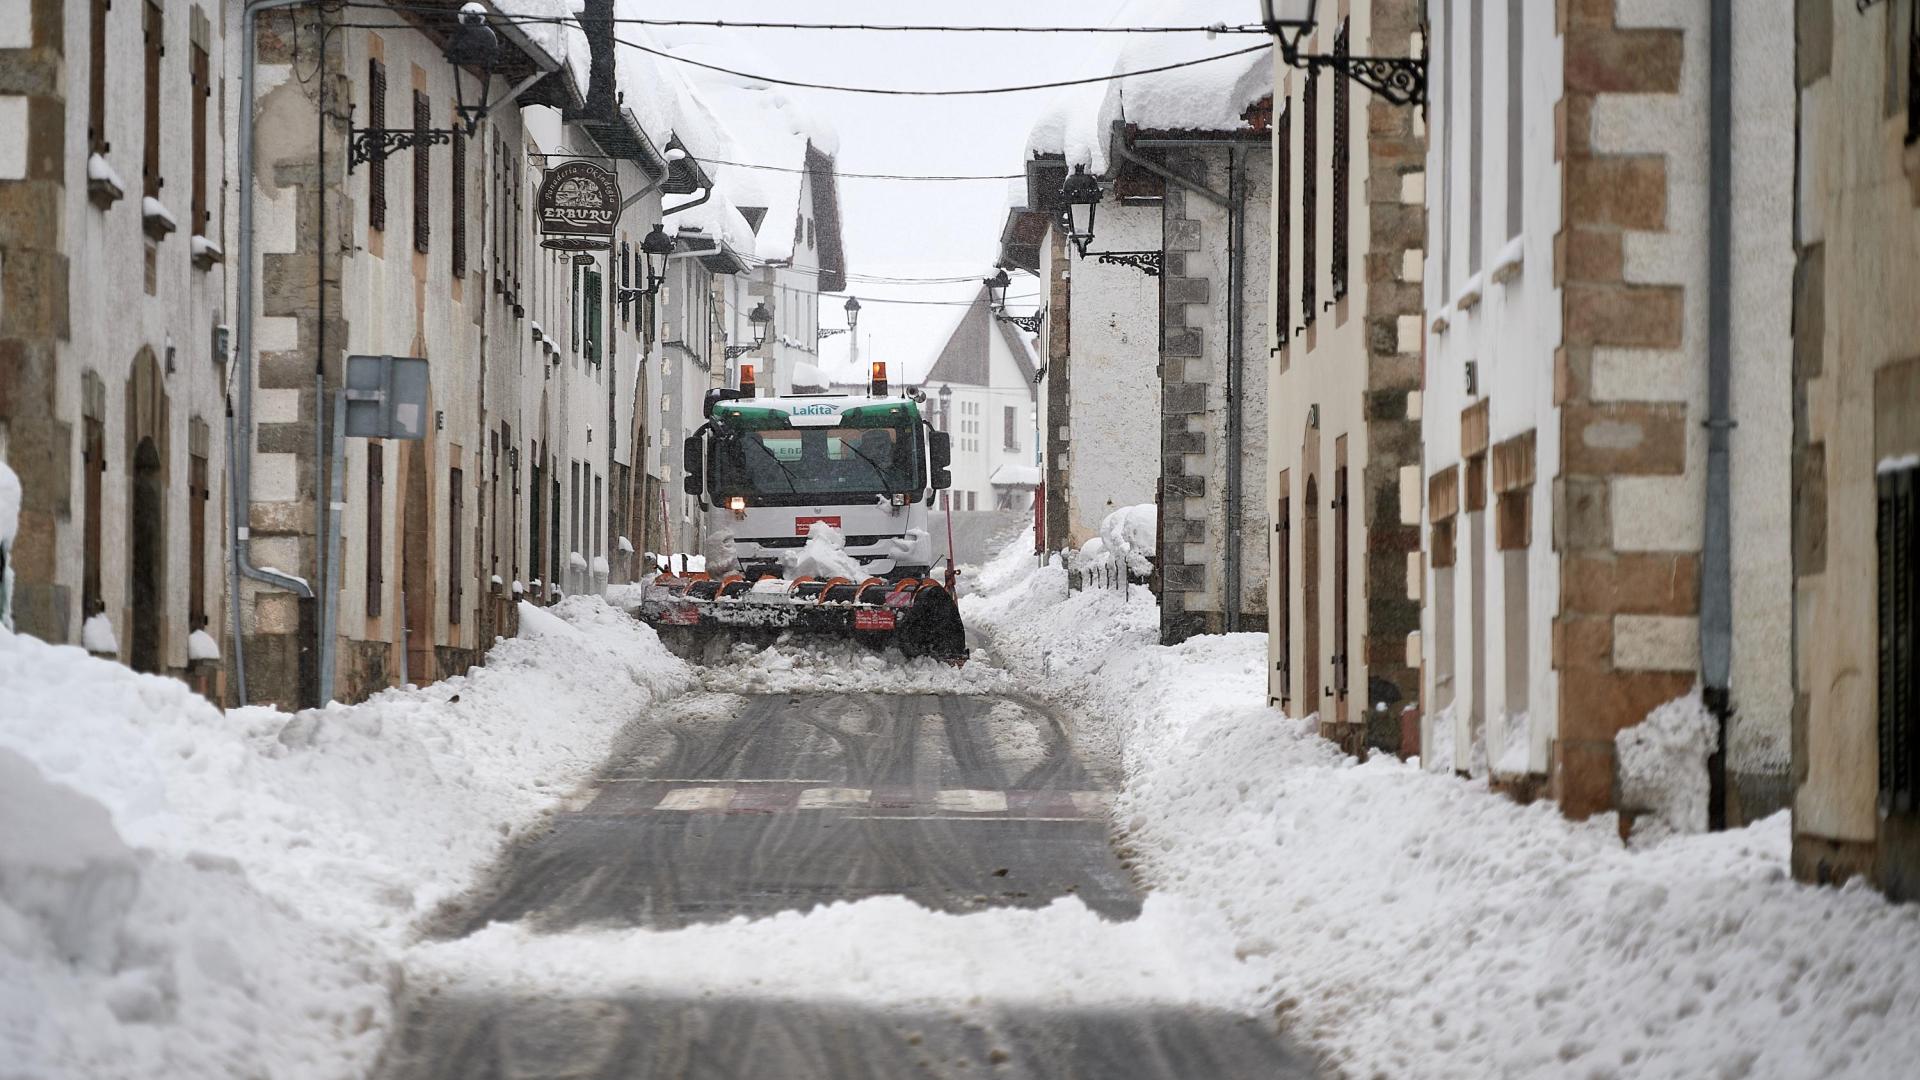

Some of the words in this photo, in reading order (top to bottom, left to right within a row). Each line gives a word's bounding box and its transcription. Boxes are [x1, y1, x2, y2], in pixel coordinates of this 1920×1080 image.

[586, 166, 616, 203] Okindegia
[544, 207, 613, 226] ERBURU
[793, 405, 832, 416] Lakita
